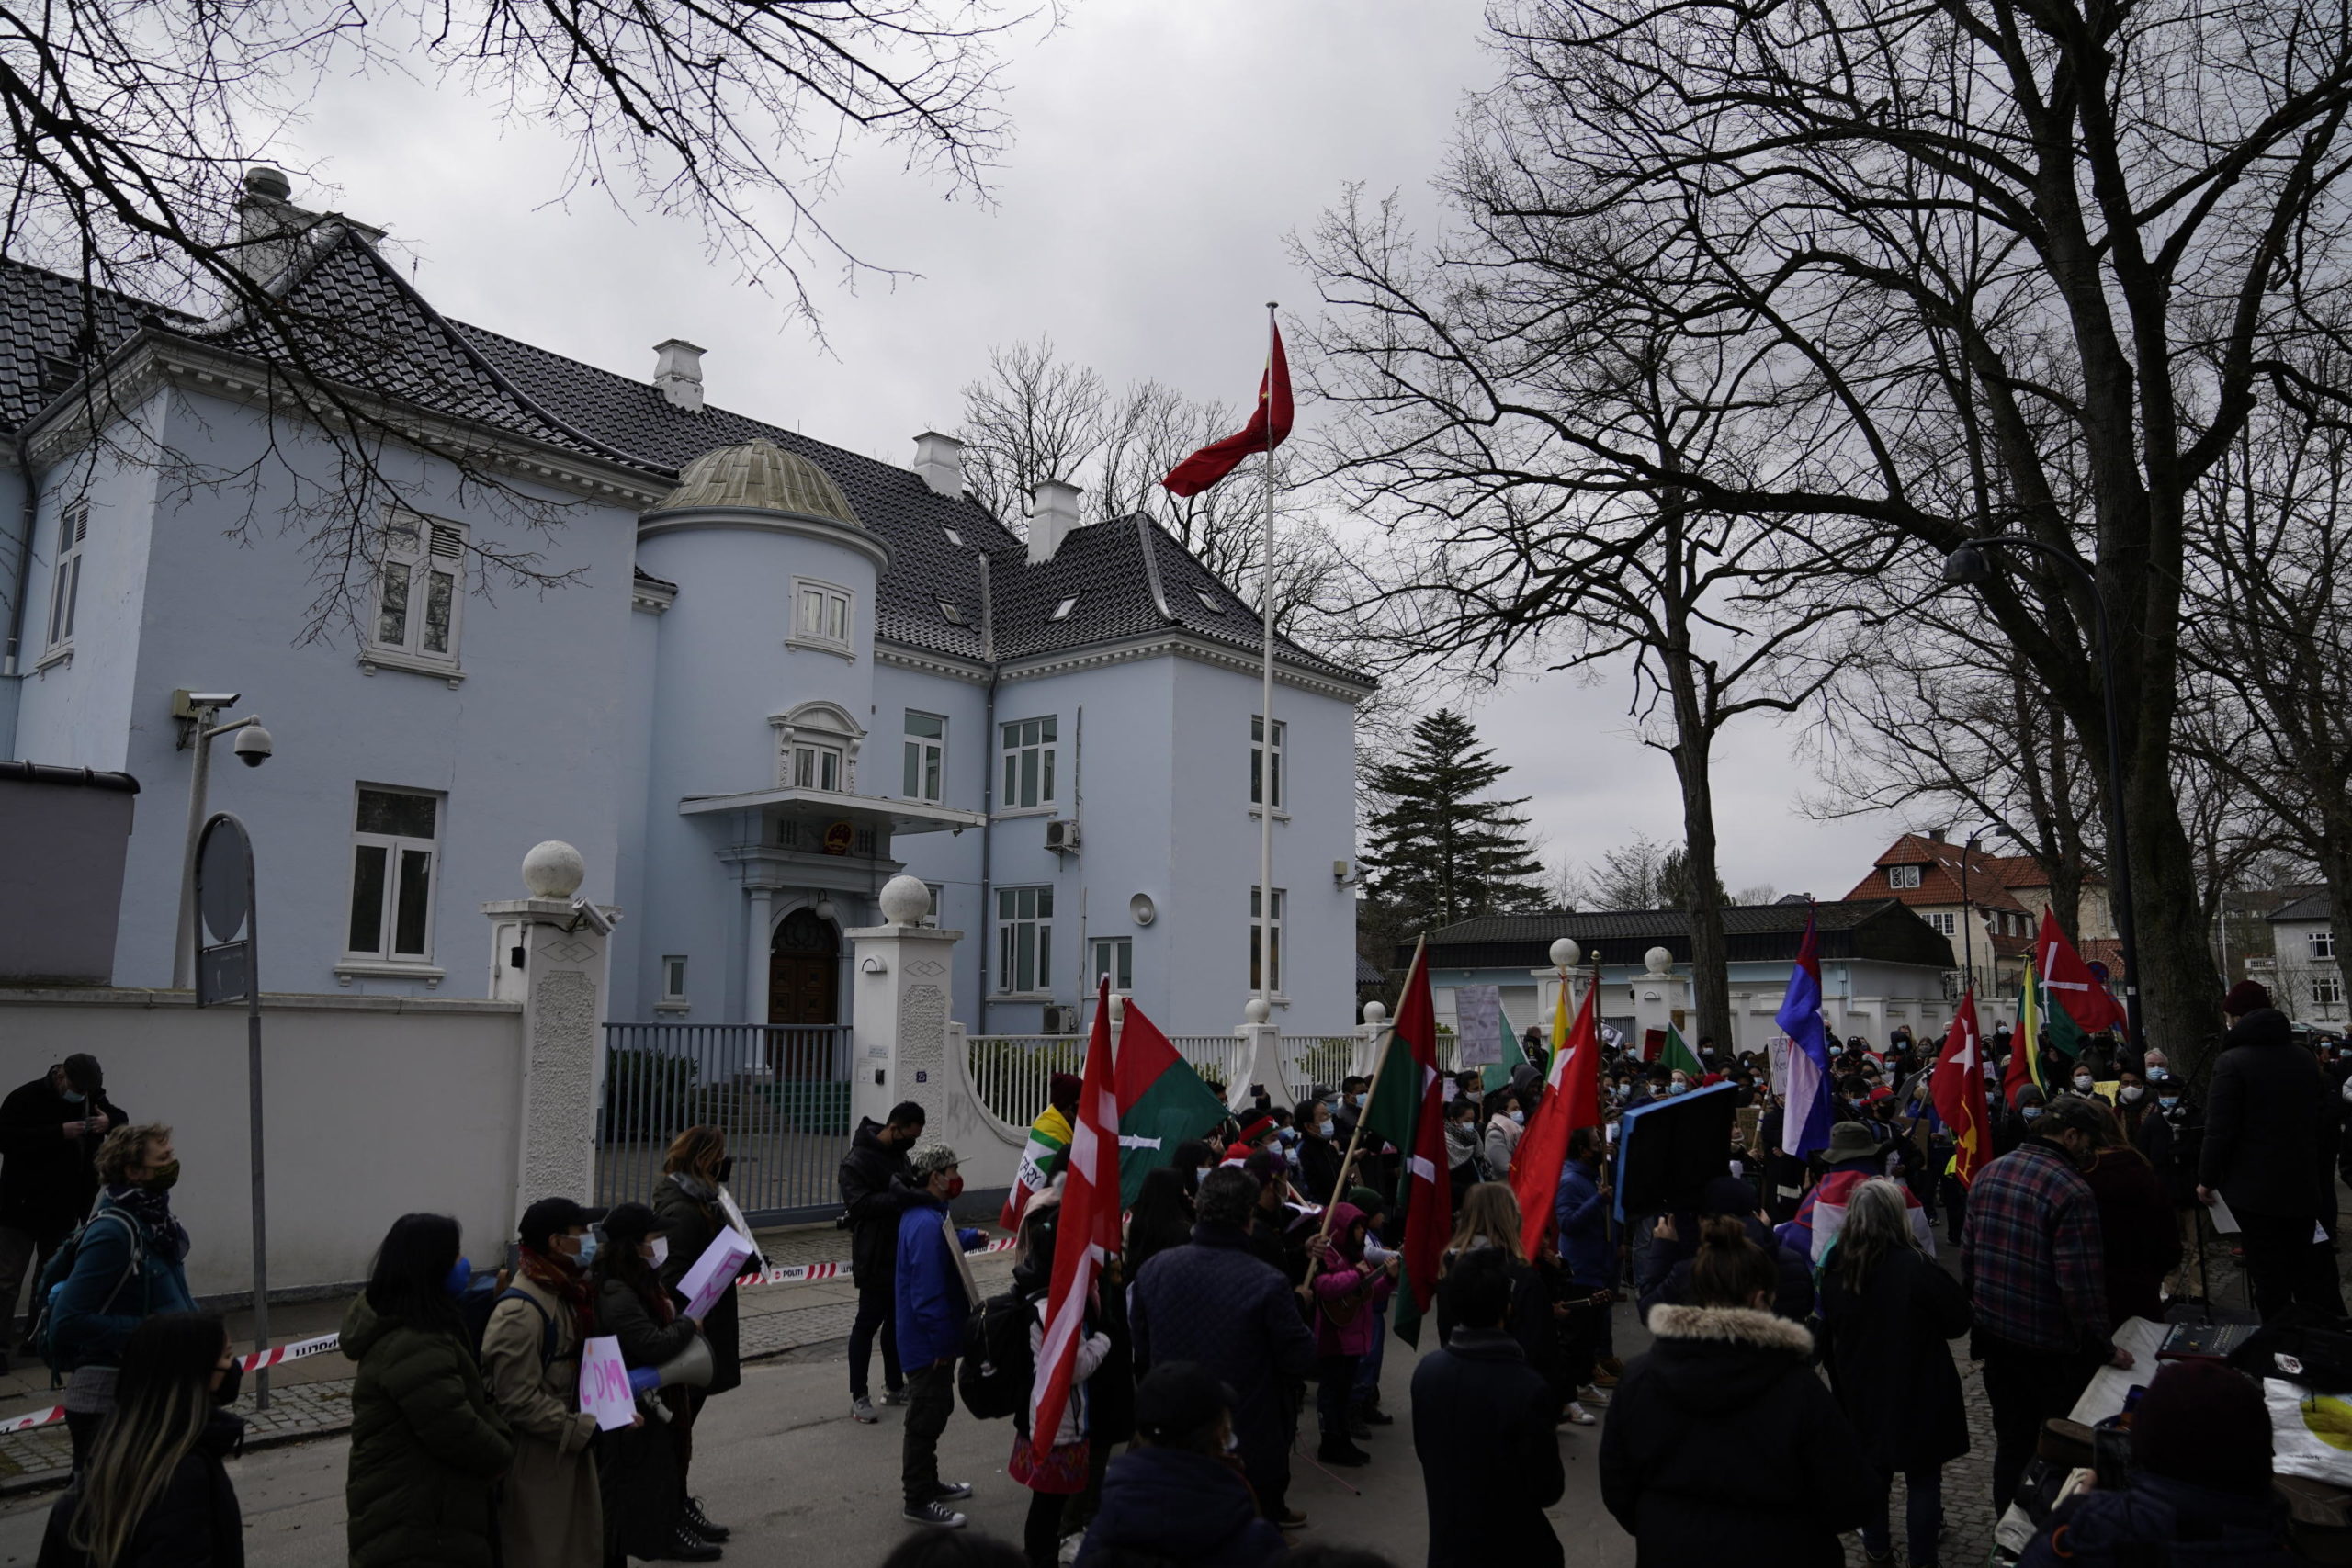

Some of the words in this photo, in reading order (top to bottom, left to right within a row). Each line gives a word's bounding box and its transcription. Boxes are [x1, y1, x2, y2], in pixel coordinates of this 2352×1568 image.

[918, 1072, 926, 1082] 25
[783, 1269, 803, 1278] POLITI
[581, 1359, 629, 1406] CDM
